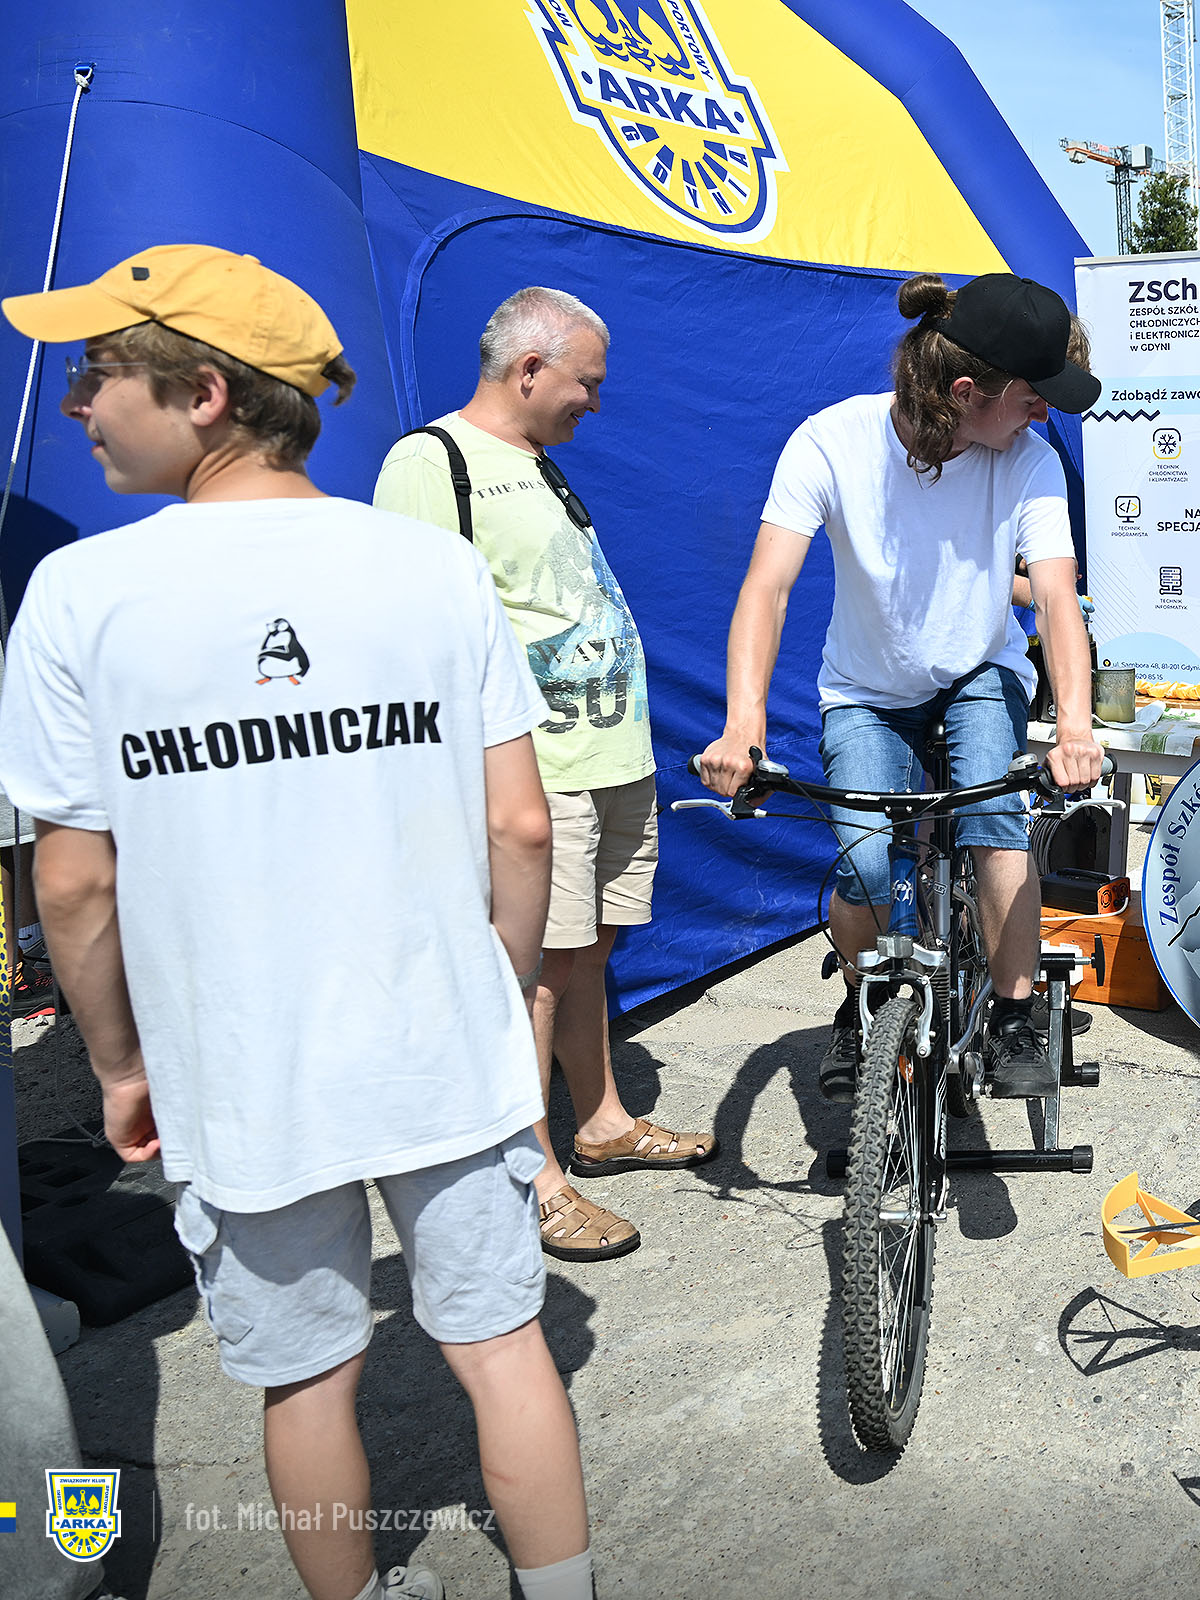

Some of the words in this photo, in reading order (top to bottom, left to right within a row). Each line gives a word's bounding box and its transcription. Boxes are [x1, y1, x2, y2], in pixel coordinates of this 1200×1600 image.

[598, 68, 740, 135] ARKA
[622, 124, 750, 216] GDYNIA
[1129, 305, 1166, 317] ZESPÓŁ
[1167, 304, 1199, 316] SZKÓŁ
[1140, 343, 1171, 352] GDYNI
[1111, 386, 1168, 404] Zdobądź
[471, 482, 516, 500] THE
[121, 701, 442, 780] CHŁODNICZAK
[1159, 843, 1181, 927] Zespół
